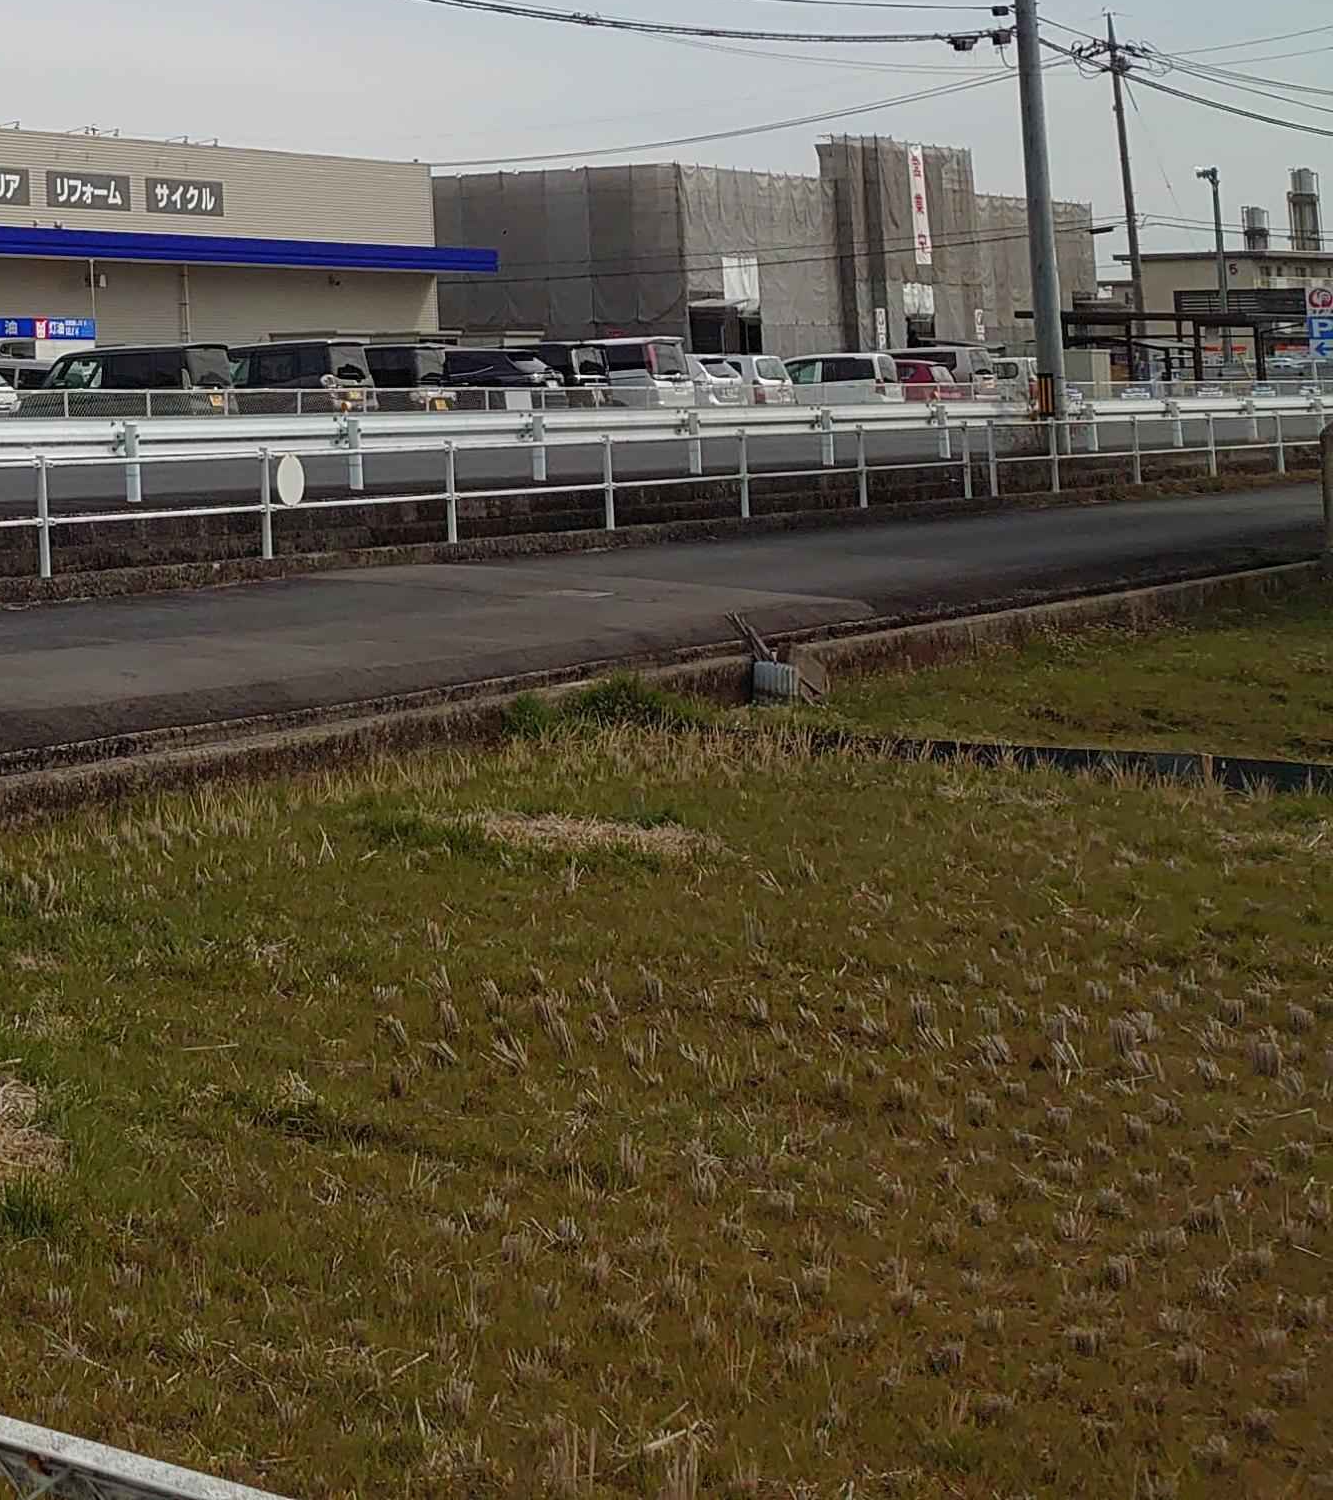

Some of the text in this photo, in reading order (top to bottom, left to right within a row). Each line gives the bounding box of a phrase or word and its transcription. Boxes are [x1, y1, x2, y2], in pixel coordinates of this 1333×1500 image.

[56, 177, 123, 206] リフォーム
[155, 183, 215, 211] サイクル
[1311, 318, 1333, 338] P
